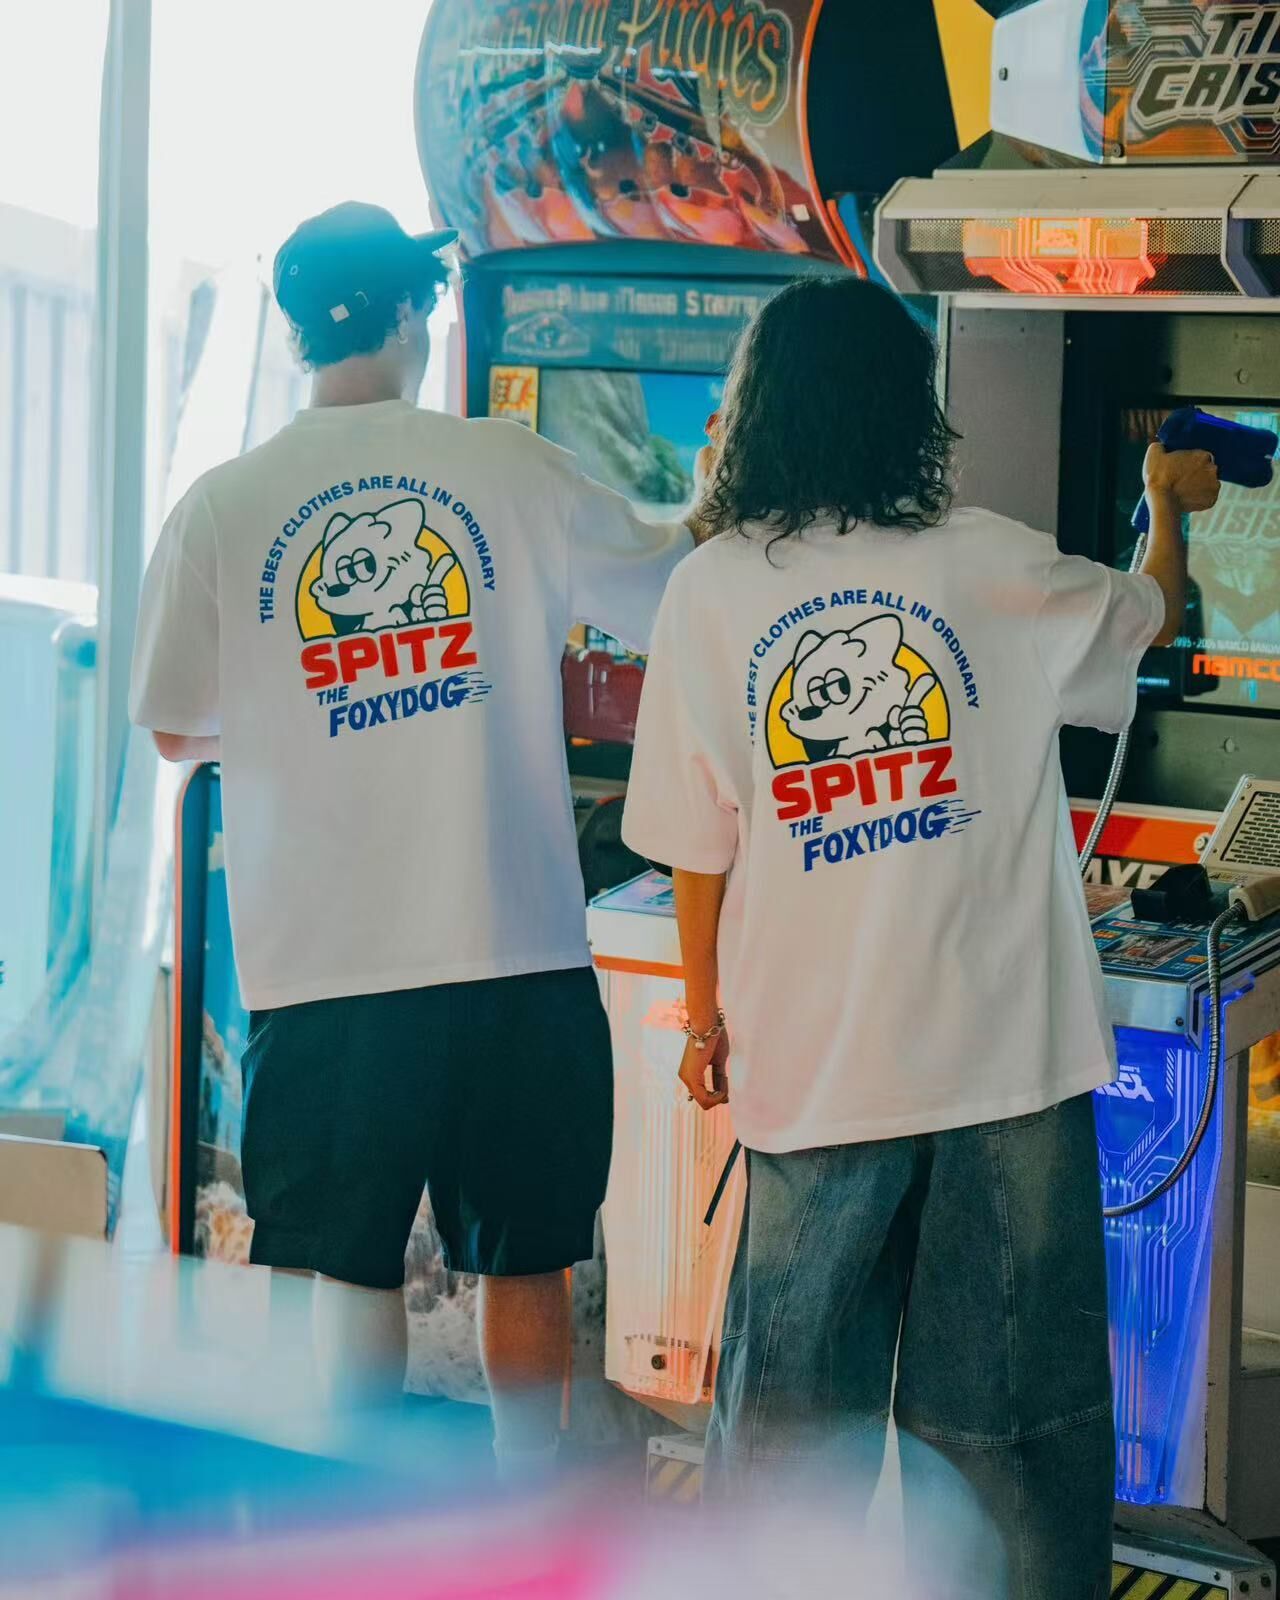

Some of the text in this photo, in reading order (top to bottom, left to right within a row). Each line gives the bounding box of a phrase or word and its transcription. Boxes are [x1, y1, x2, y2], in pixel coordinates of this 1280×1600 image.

[1209, 12, 1280, 55] TI
[260, 475, 496, 623] THE BEST CLOTHES ARE ALL IN ORDINARY
[300, 621, 478, 690] SPITZ
[753, 596, 826, 659] CLOTHES
[830, 589, 868, 608] ARE
[871, 590, 906, 612] ALL
[909, 601, 933, 623] IN
[931, 617, 980, 710] ORDINARY
[316, 684, 350, 706] THE
[329, 671, 478, 738] FOXYDOG
[771, 746, 958, 821] SPITZ
[789, 816, 823, 838] THE
[803, 799, 962, 873] FOXYDOG
